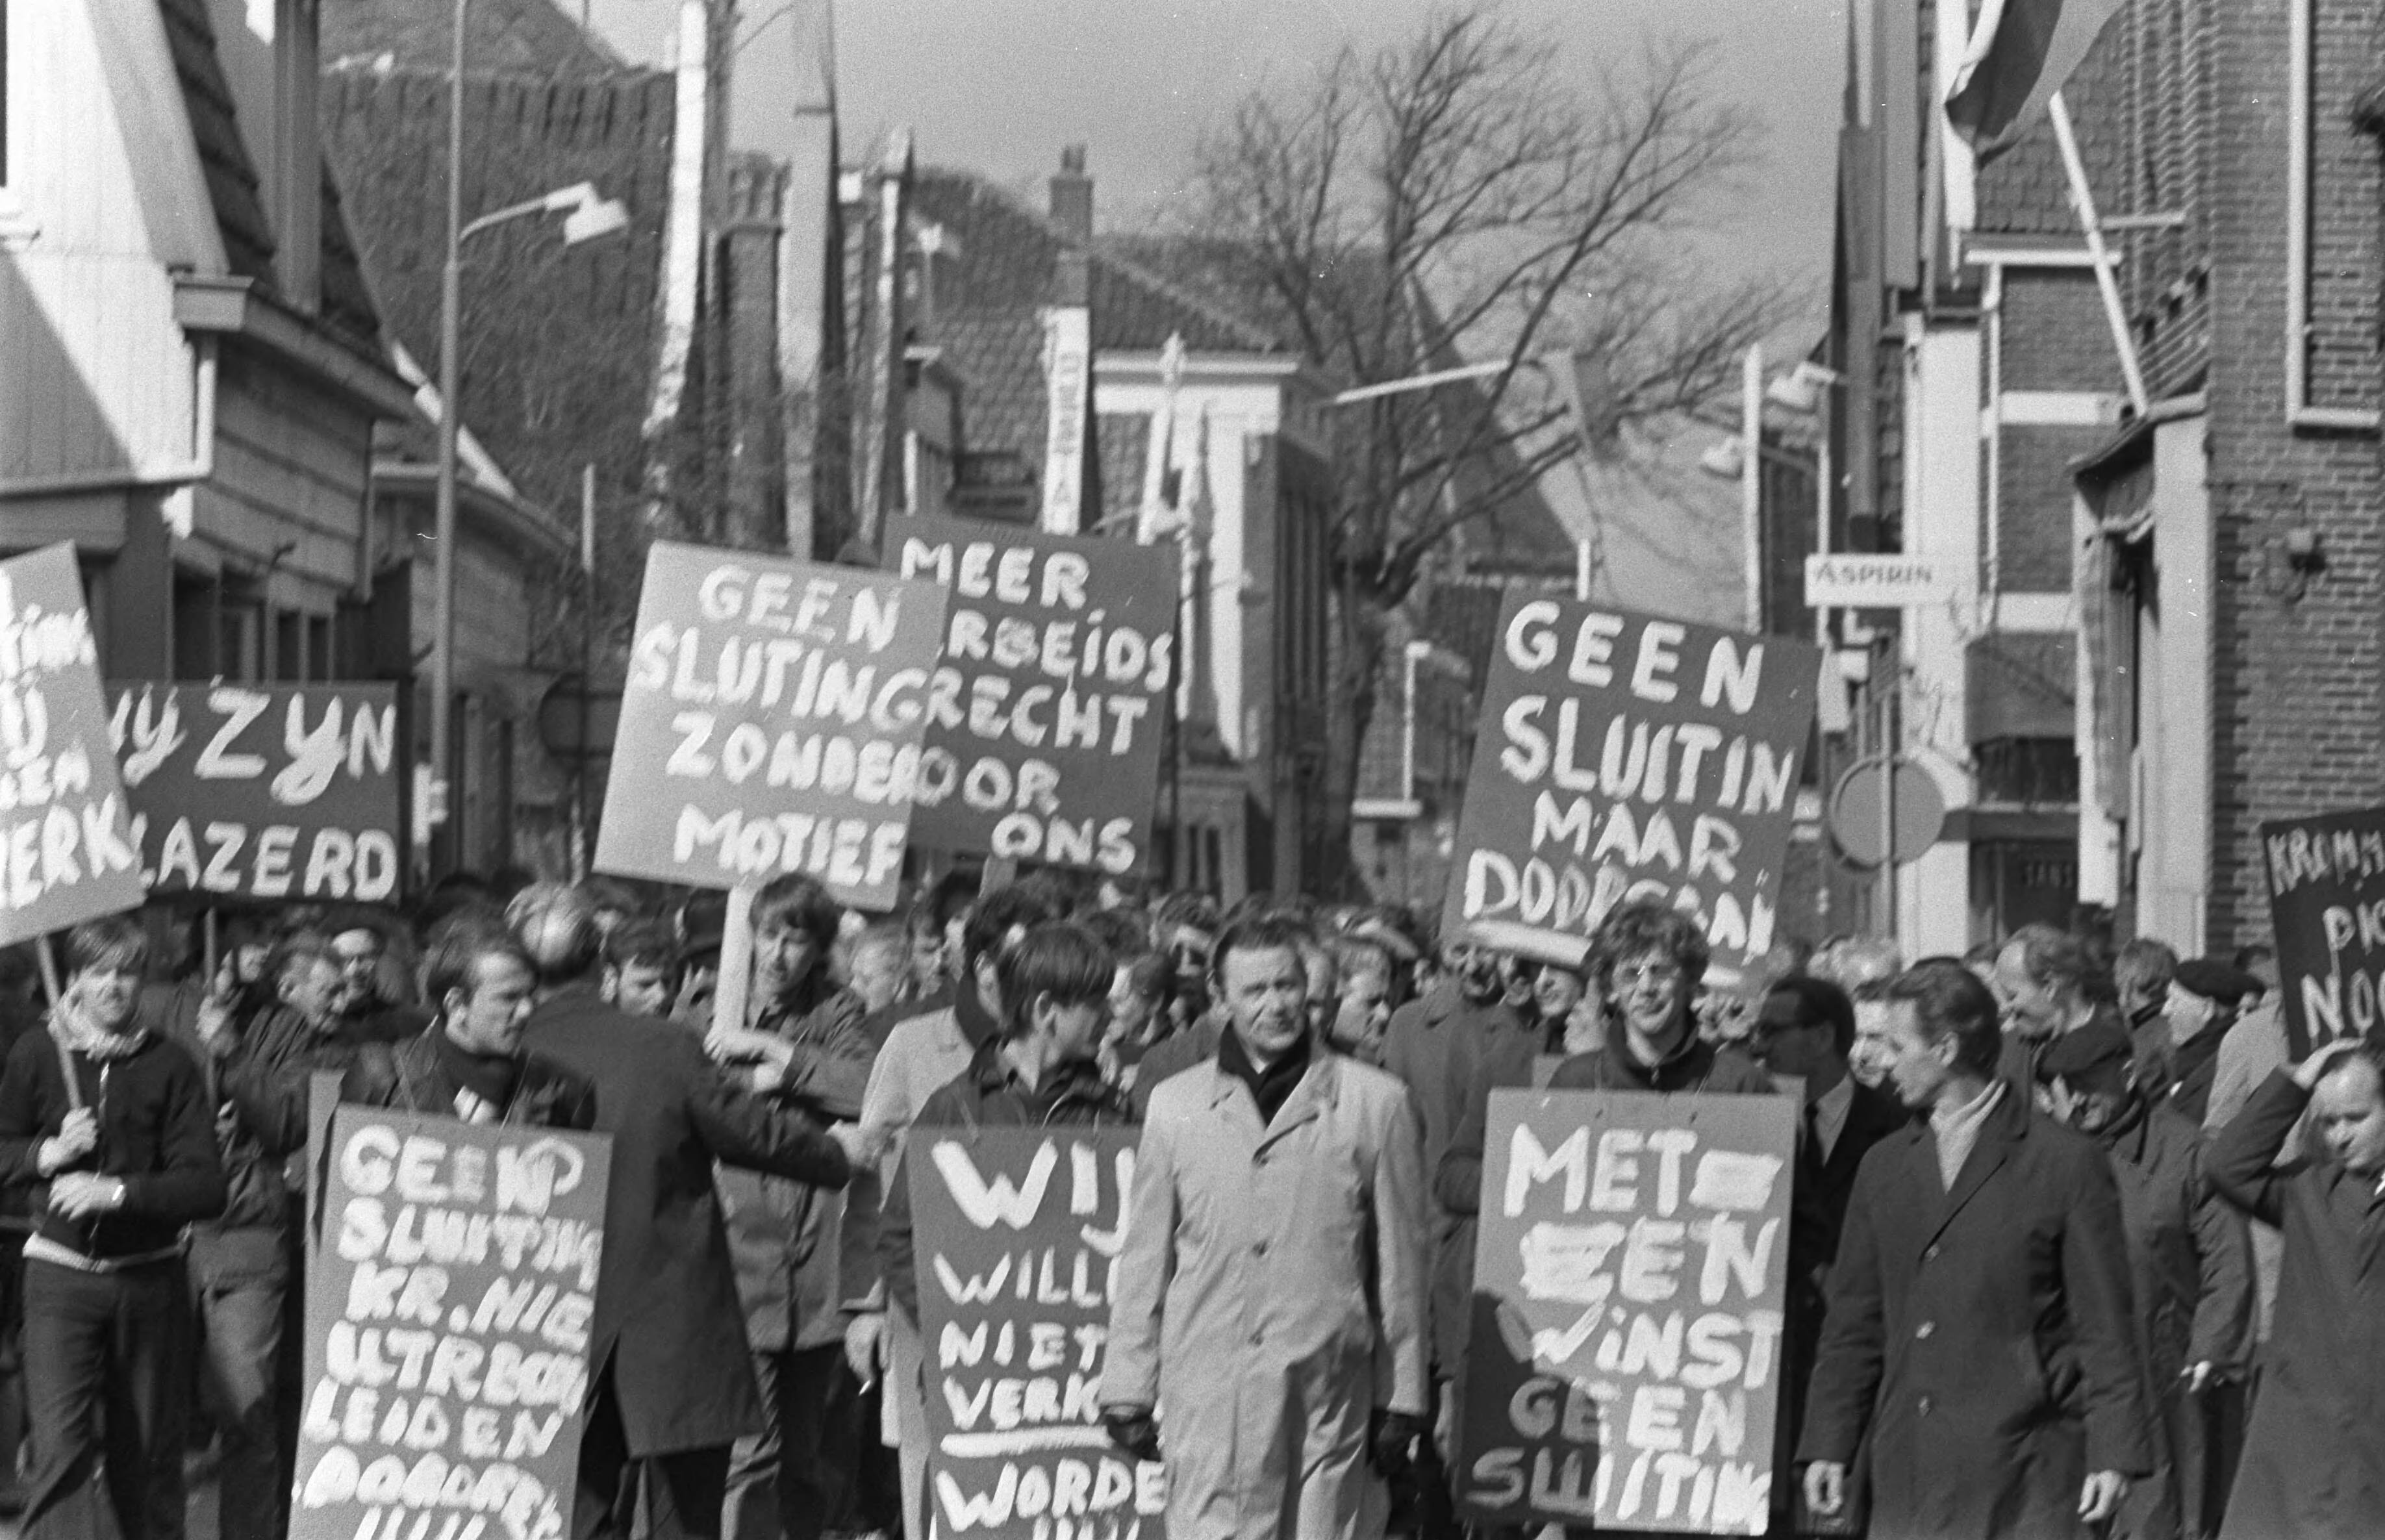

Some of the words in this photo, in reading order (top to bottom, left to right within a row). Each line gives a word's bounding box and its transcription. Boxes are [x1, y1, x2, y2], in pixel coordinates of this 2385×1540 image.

[698, 562, 903, 653] GEEN
[900, 536, 1090, 611] MEER
[1505, 600, 1765, 714] GEEN
[925, 666, 1150, 757] RECHT
[1500, 694, 1796, 816] SLUITIN
[0, 790, 133, 911] ERK
[674, 803, 907, 887] MOTIEF
[991, 811, 1137, 874] ONS
[1530, 789, 1743, 872] MAAR
[931, 1137, 1136, 1256] WIJ
[1504, 1122, 1698, 1218] MET
[933, 1245, 1121, 1307] WILL
[939, 1319, 1105, 1370] NIET
[304, 1374, 564, 1461] LEIDEN
